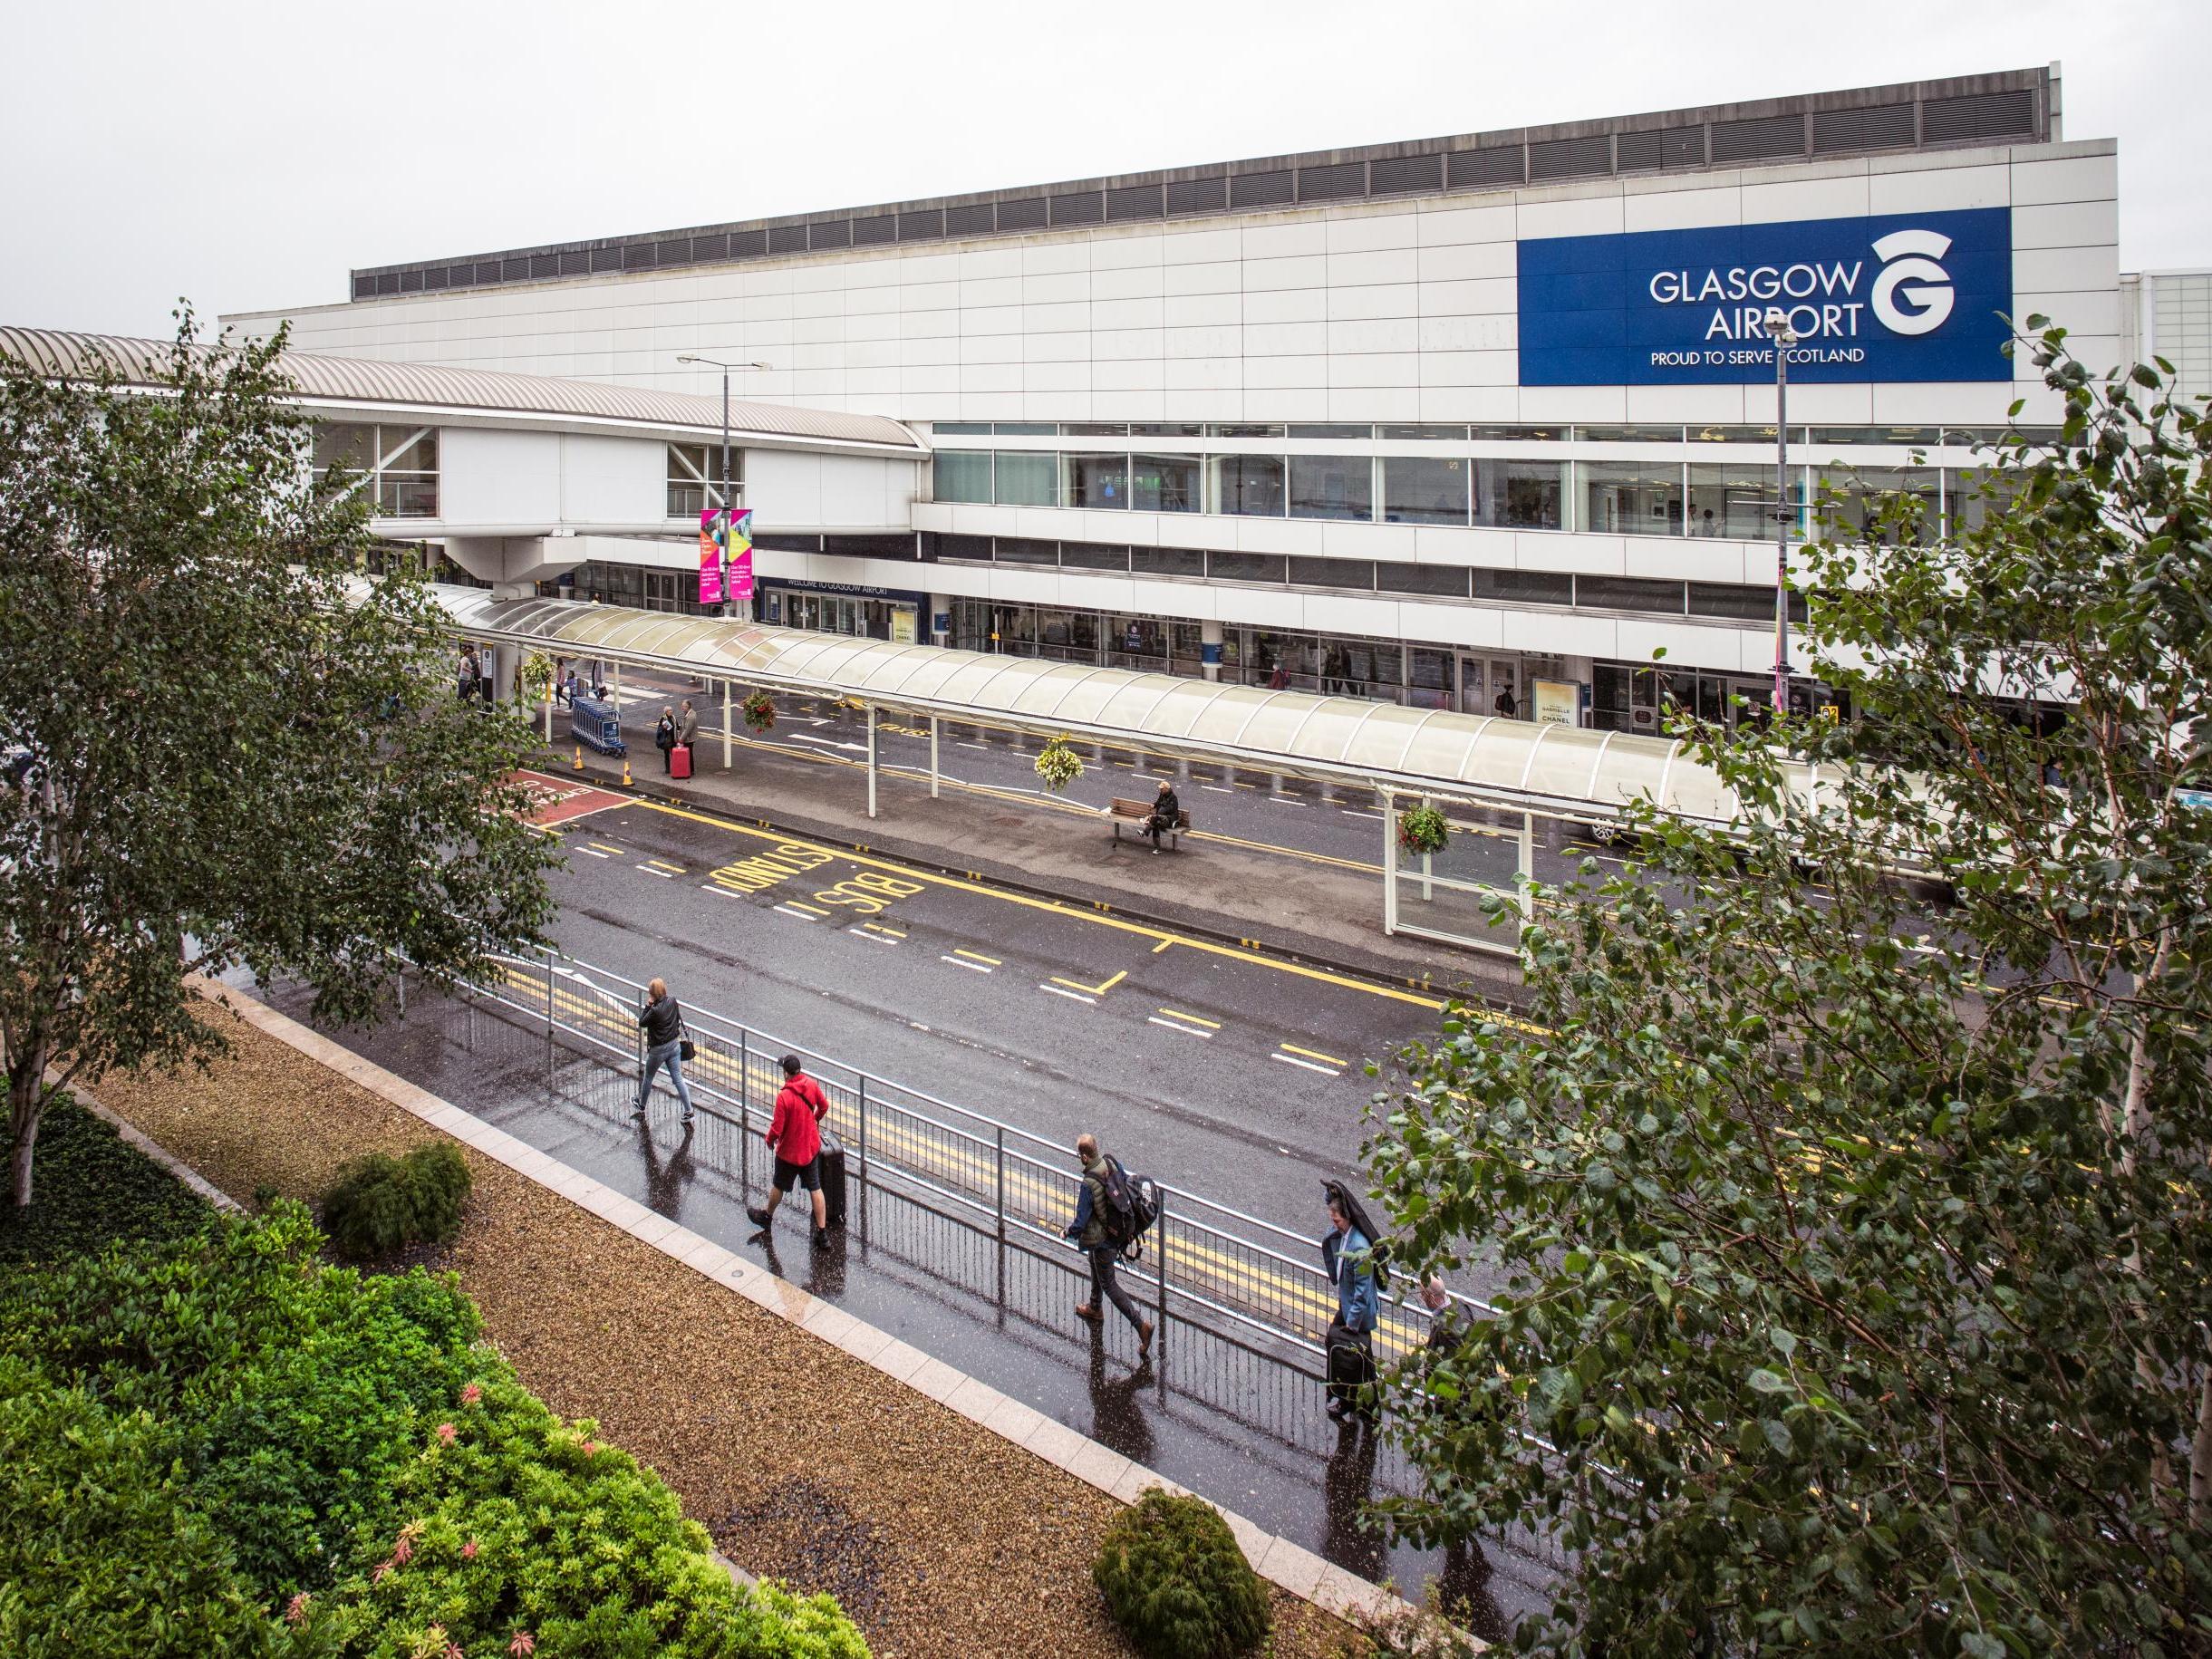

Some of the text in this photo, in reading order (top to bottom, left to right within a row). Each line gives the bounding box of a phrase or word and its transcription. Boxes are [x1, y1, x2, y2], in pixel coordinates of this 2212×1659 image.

[1649, 261, 1863, 304] GLASGOW
[1651, 348, 1865, 366] PROUD TO SERVE COTLAND
[1541, 716, 1570, 724] CHANEL
[709, 844, 834, 893] STAND
[812, 872, 925, 913] BUS
